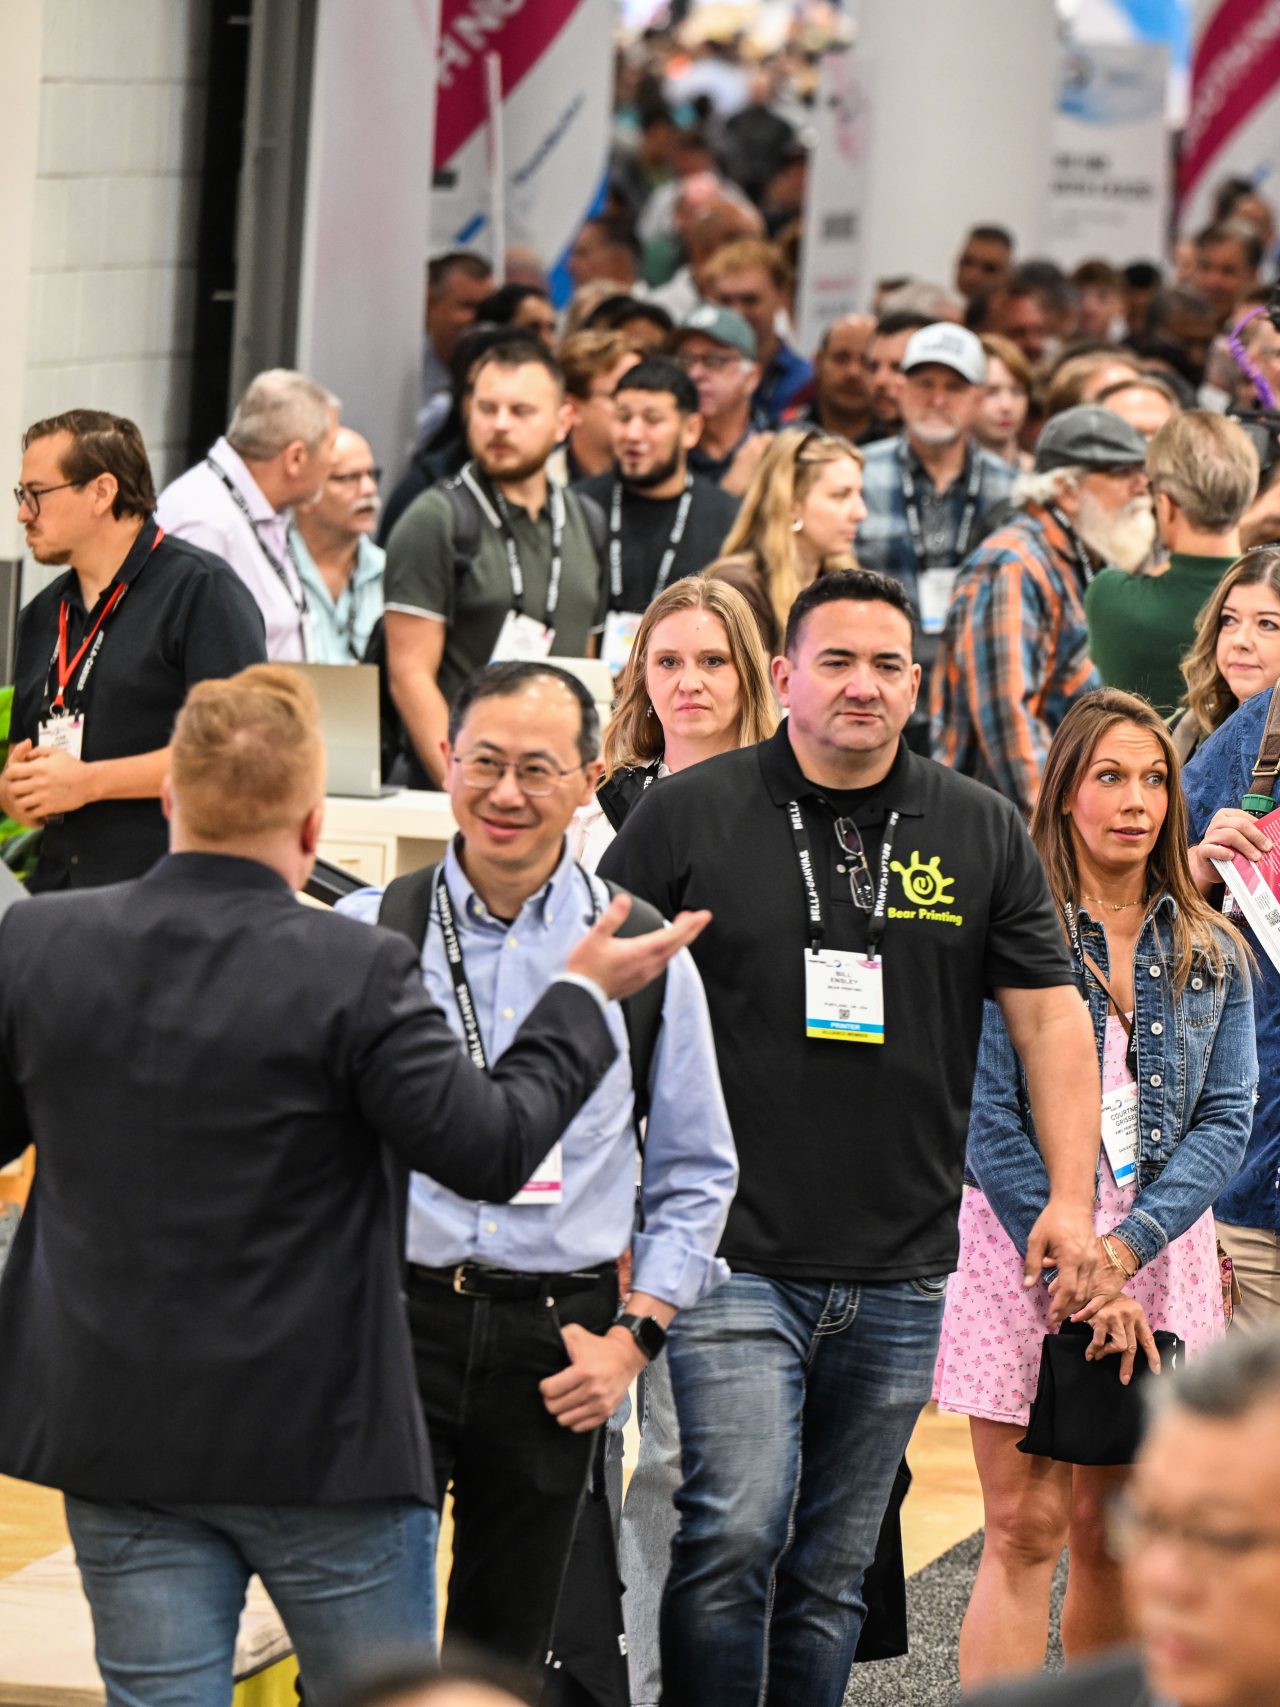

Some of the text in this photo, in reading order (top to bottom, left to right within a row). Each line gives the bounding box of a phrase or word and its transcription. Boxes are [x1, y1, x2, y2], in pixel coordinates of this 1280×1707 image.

[799, 849, 821, 921] BELLA+CANVAS
[874, 842, 892, 917] BELLA+CANVAS
[887, 907, 963, 926] Bear Printing
[1111, 1105, 1137, 1120] COURTNE
